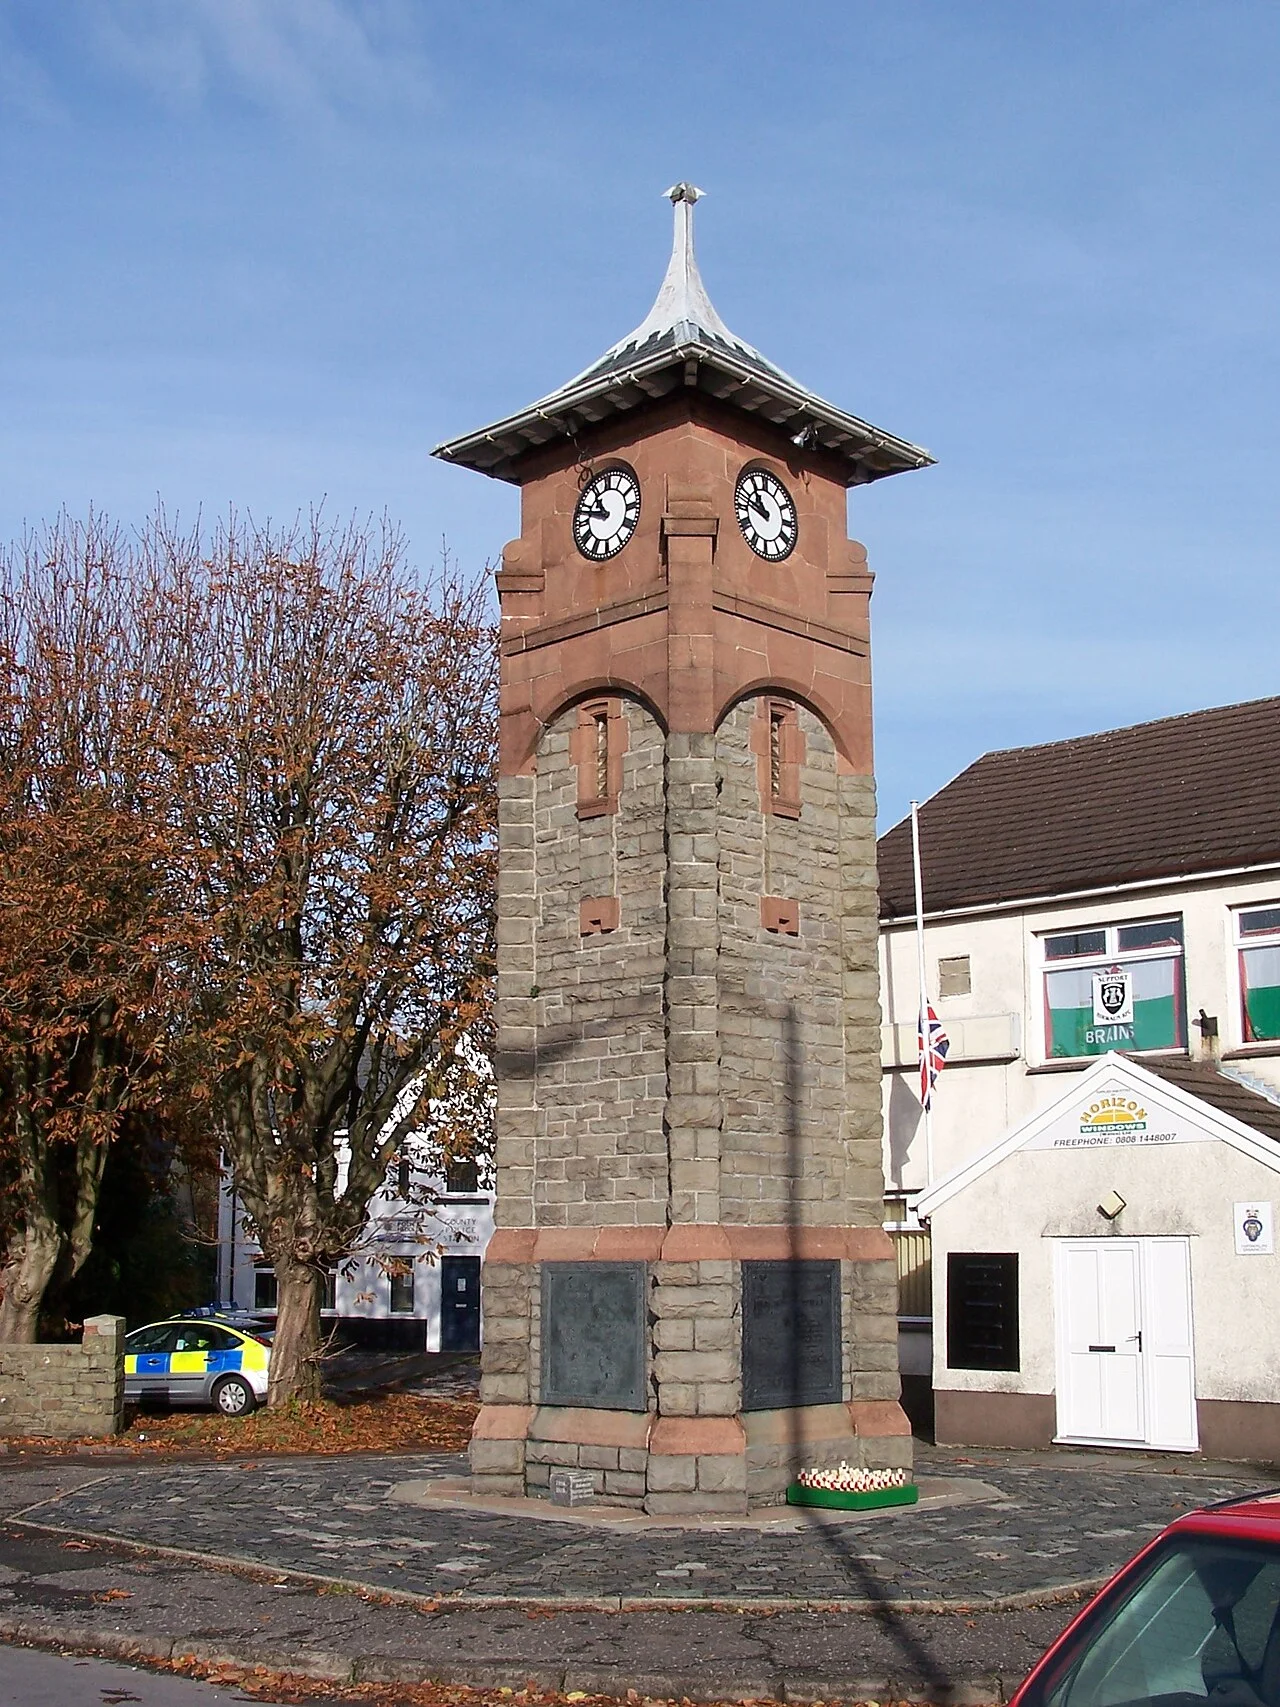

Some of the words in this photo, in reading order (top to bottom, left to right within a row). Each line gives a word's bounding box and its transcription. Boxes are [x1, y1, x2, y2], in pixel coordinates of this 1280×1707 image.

[1098, 974, 1128, 982] SUPPORT
[1085, 1025, 1135, 1044] BRAINS
[1080, 1097, 1148, 1123] HORIZON
[1081, 1122, 1144, 1133] WINDOWS
[1053, 1137, 1113, 1147] FREEPHONE:
[1115, 1136, 1137, 1144] 0808
[1139, 1133, 1177, 1143] 1448007
[445, 1218, 477, 1226] COUNTY
